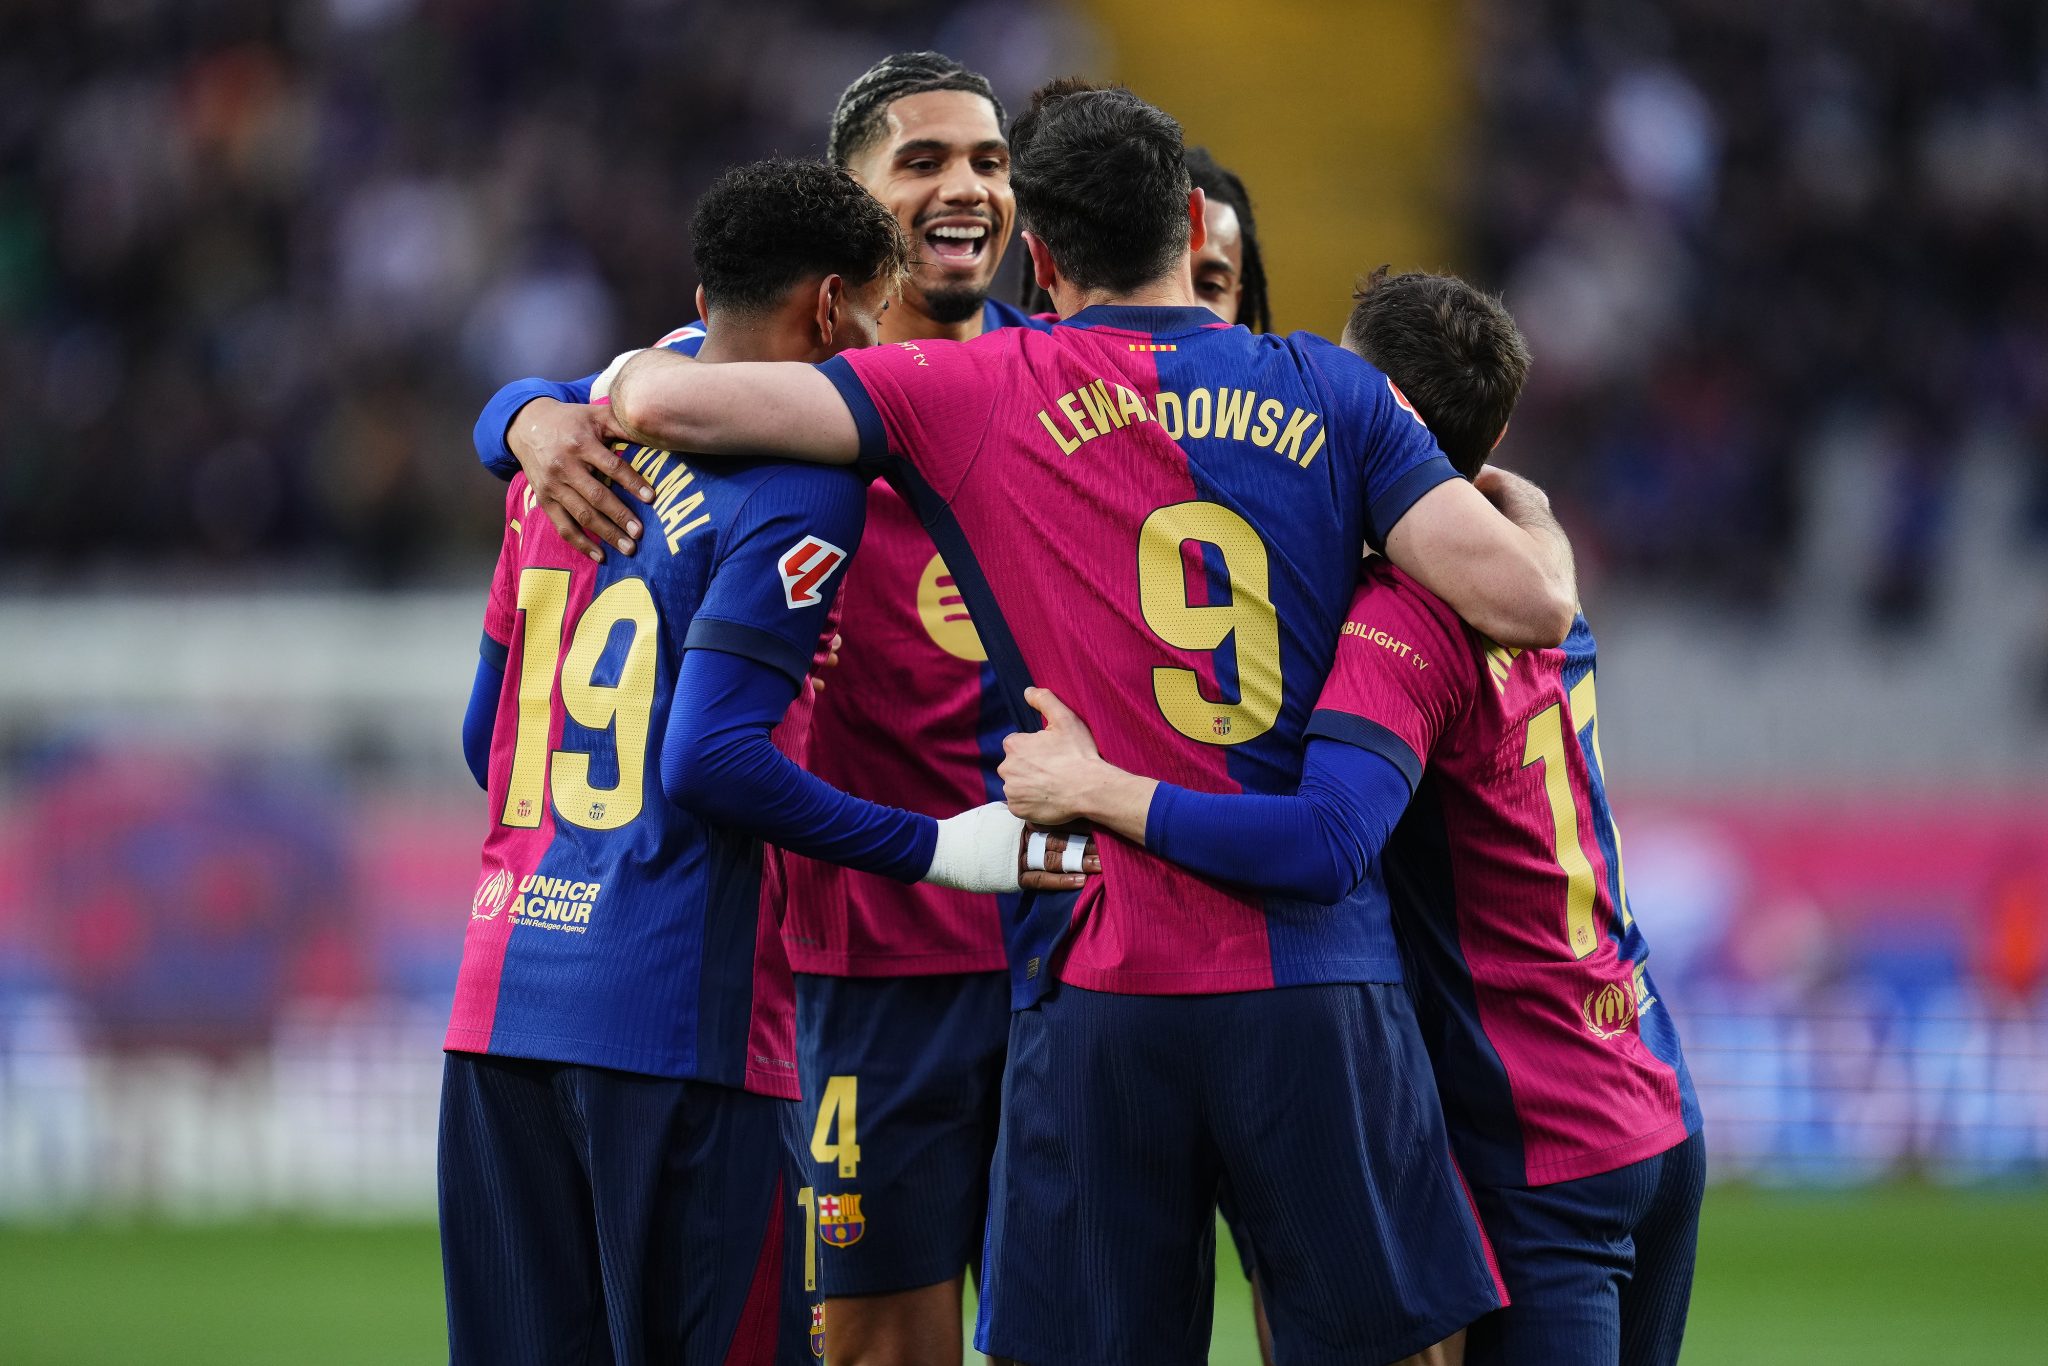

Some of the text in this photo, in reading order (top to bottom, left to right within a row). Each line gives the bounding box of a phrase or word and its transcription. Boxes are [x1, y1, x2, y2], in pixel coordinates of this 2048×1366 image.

[1036, 377, 1326, 468] LEWADOWSKI
[1137, 500, 1283, 746] 9
[1340, 621, 1429, 671] BILIGHT tv
[501, 567, 659, 831] 19
[508, 893, 592, 924] ACNUR
[518, 874, 601, 902] UNHCR
[507, 915, 587, 934] The UN Refugee Agency
[810, 1075, 861, 1178] 4
